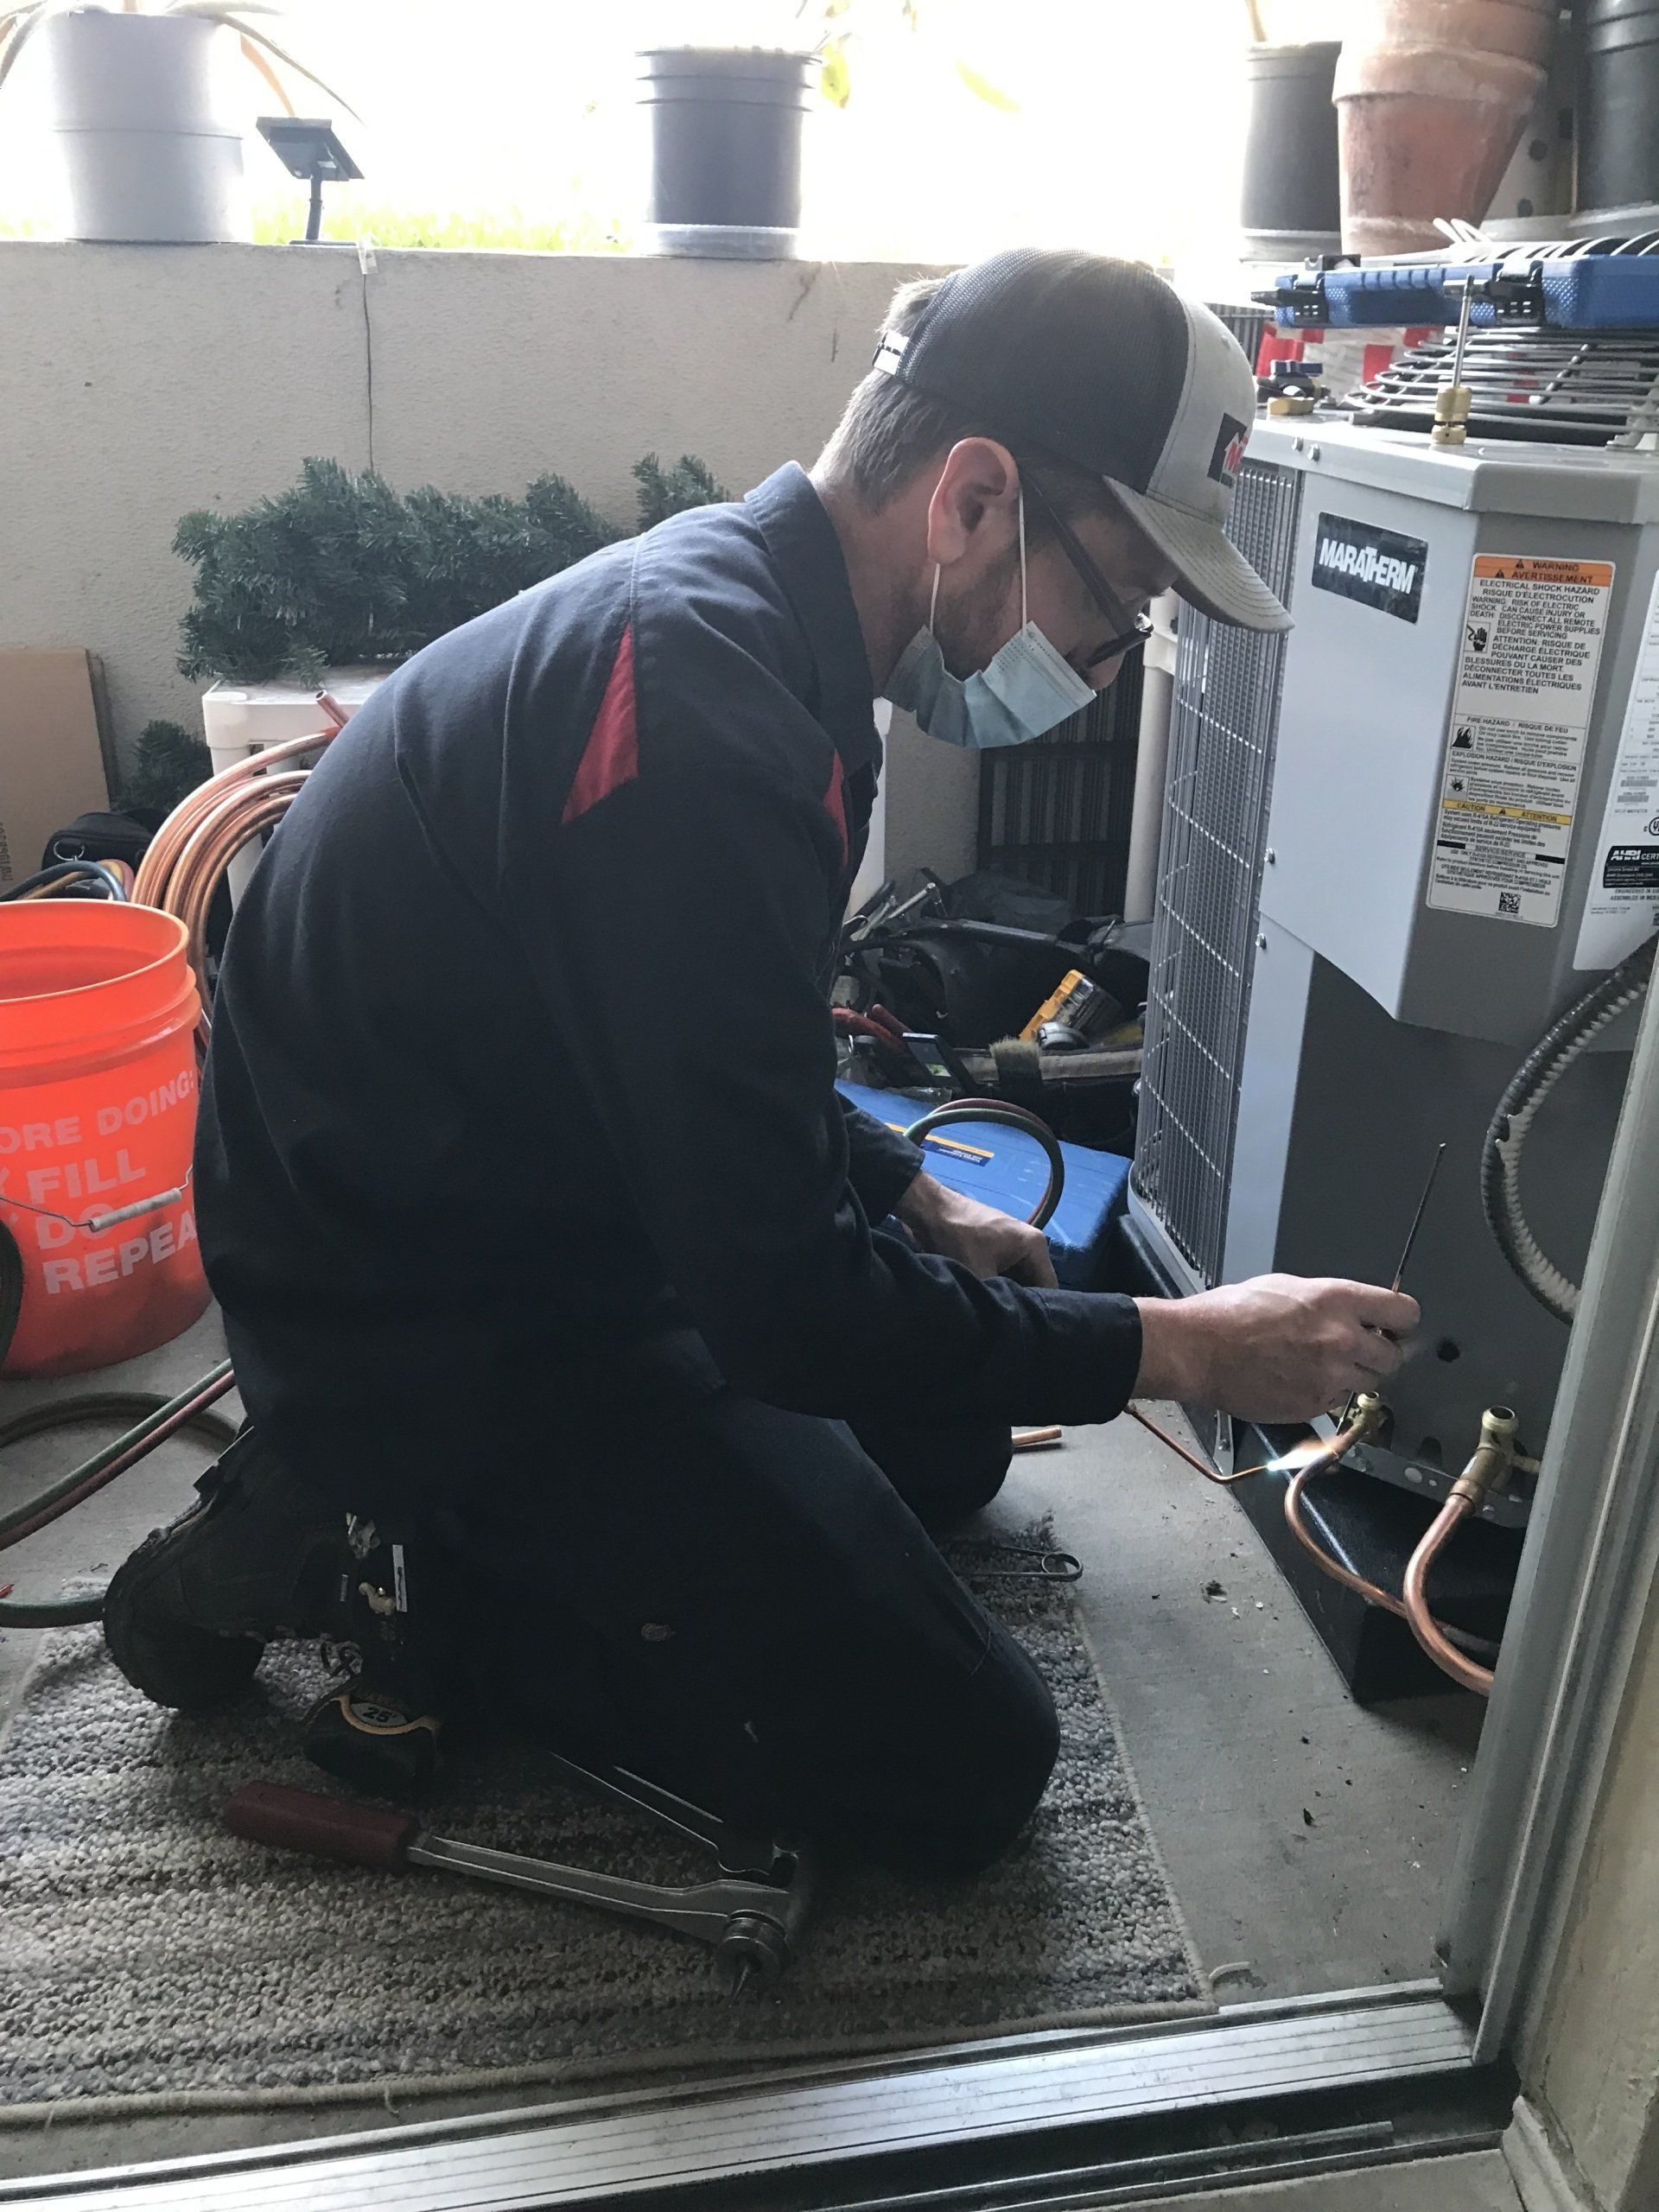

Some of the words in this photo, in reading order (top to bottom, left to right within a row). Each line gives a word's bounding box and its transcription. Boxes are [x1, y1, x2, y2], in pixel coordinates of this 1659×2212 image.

[1319, 537, 1415, 594] MARATHERM
[1533, 562, 1580, 572] WARNING
[1512, 570, 1592, 584] AVERTISSEMENT
[1480, 580, 1530, 590] ELECTRICAL
[1533, 583, 1561, 593] SHOCK
[1565, 586, 1600, 595] HAZARD
[1483, 588, 1513, 598] RISQUE
[1519, 607, 1543, 615] CAUSE
[1546, 609, 1572, 618] INJURY
[1542, 602, 1580, 611] ELECTRIC
[1499, 613, 1546, 622] DISCONNECT
[1564, 619, 1595, 627] REMOTE
[1497, 620, 1534, 629] ELECTRIC
[1564, 626, 1600, 635] SUPPLIES
[1528, 630, 1567, 639] SERVICING
[1542, 640, 1573, 649] RISQUE
[1465, 656, 1511, 668] BLESSURES
[1491, 652, 1528, 661] POUVANT
[1530, 655, 1563, 664] CAUSER
[1463, 672, 1524, 684] ALIMENTATIONS
[1525, 671, 1555, 679] TOUTES
[1462, 680, 1486, 689] AVANT
[1518, 722, 1542, 731] RISQUE
[1452, 750, 1485, 760] EXPLOSION
[1486, 754, 1510, 763] HAZARD
[1514, 758, 1535, 766] RISQUE
[1457, 803, 1485, 811] CAUTION
[1521, 810, 1557, 822] ATTENTION
[1611, 850, 1642, 861] AHRI
[27, 1149, 146, 1205] FILL
[35, 1204, 116, 1249] DO
